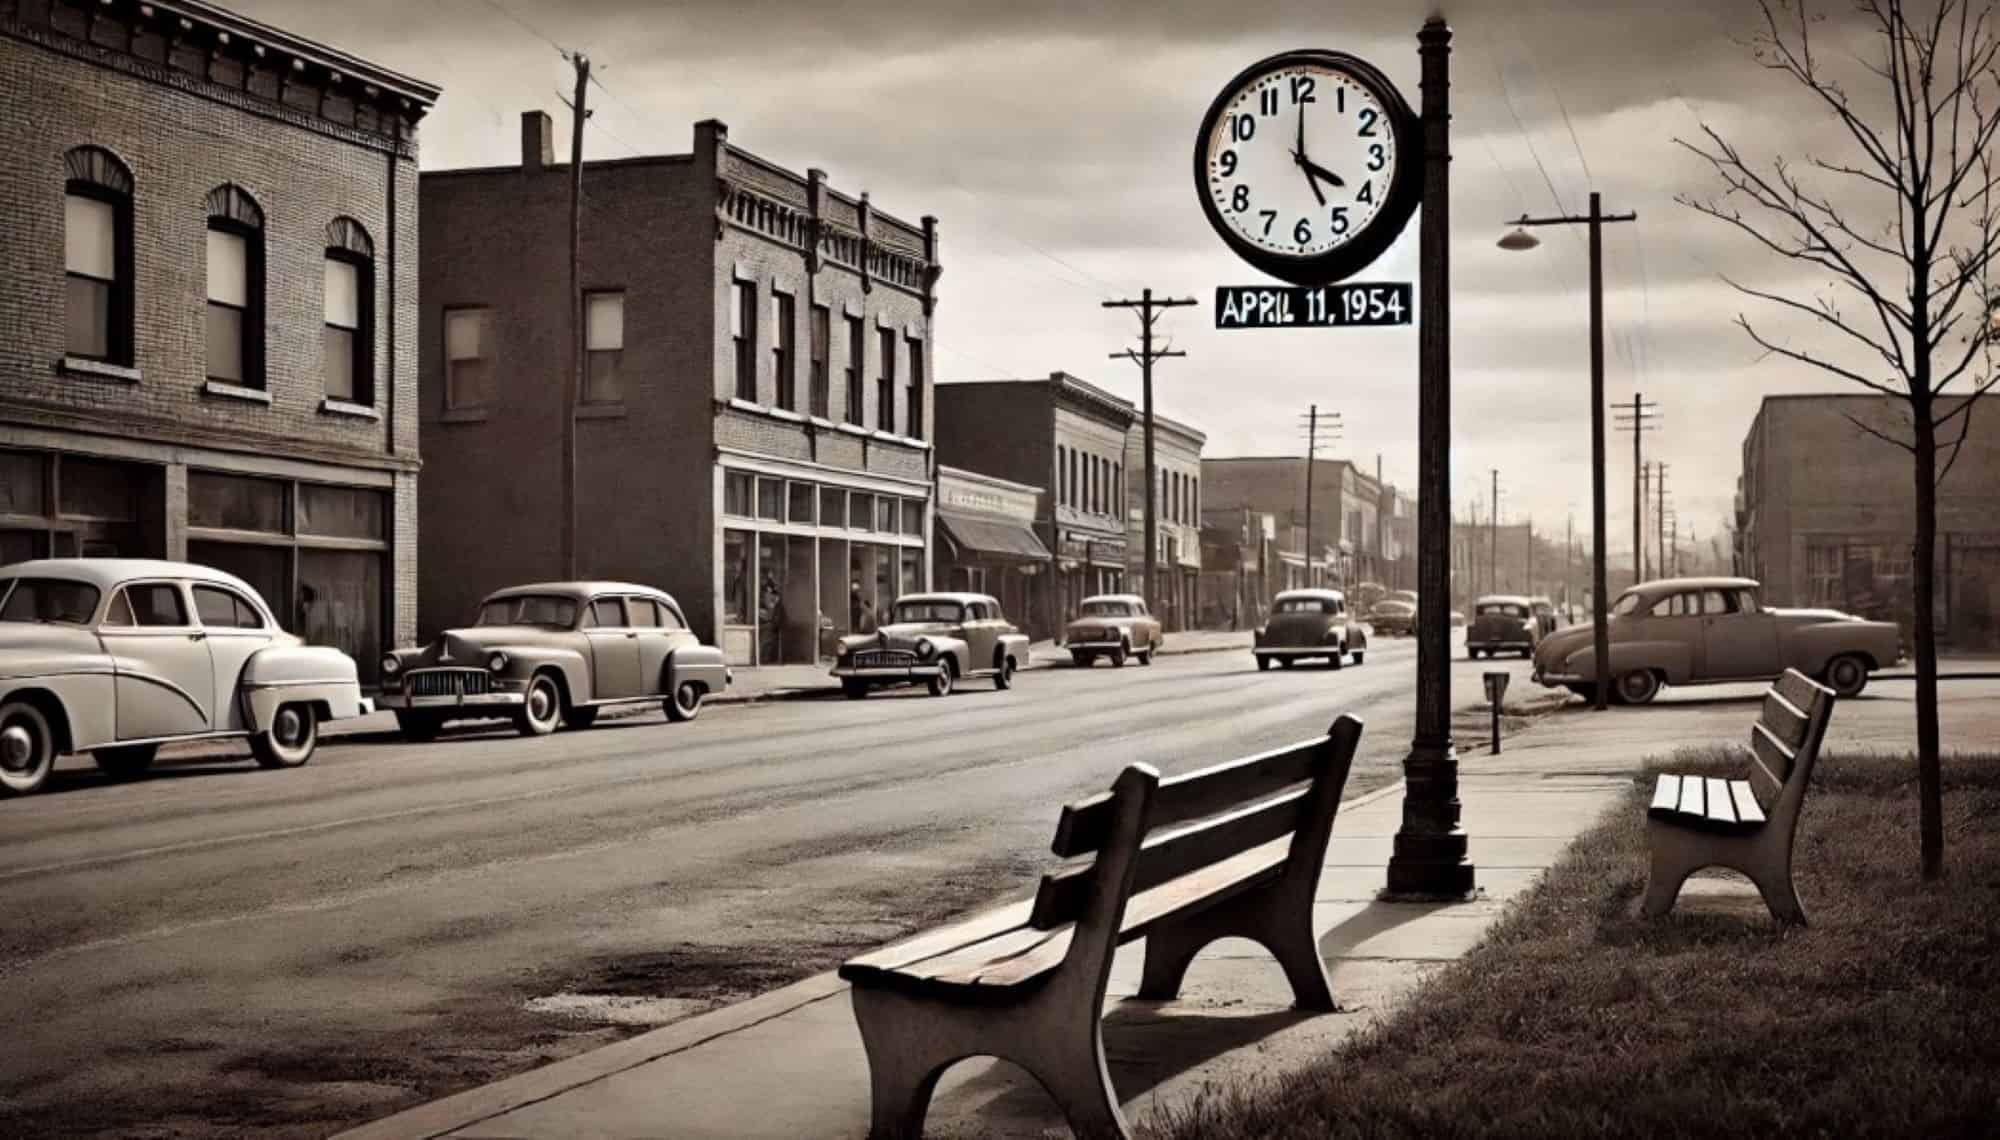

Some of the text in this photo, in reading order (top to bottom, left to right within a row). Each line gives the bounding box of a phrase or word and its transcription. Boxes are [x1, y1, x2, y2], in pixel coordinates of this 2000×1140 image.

[1260, 88, 1278, 116] 11
[1290, 76, 1316, 104] 12
[1336, 86, 1345, 113] 1
[1231, 113, 1256, 142] 10
[1357, 108, 1379, 137] 2
[1219, 149, 1238, 177] 9
[1367, 143, 1385, 171] 3
[1232, 184, 1250, 212] 8
[1356, 180, 1373, 205] 4
[1259, 210, 1277, 236] 7
[1293, 218, 1312, 244] 6
[1331, 206, 1349, 234] 5
[1220, 290, 1295, 324] APRIL
[1341, 288, 1406, 321] 1954
